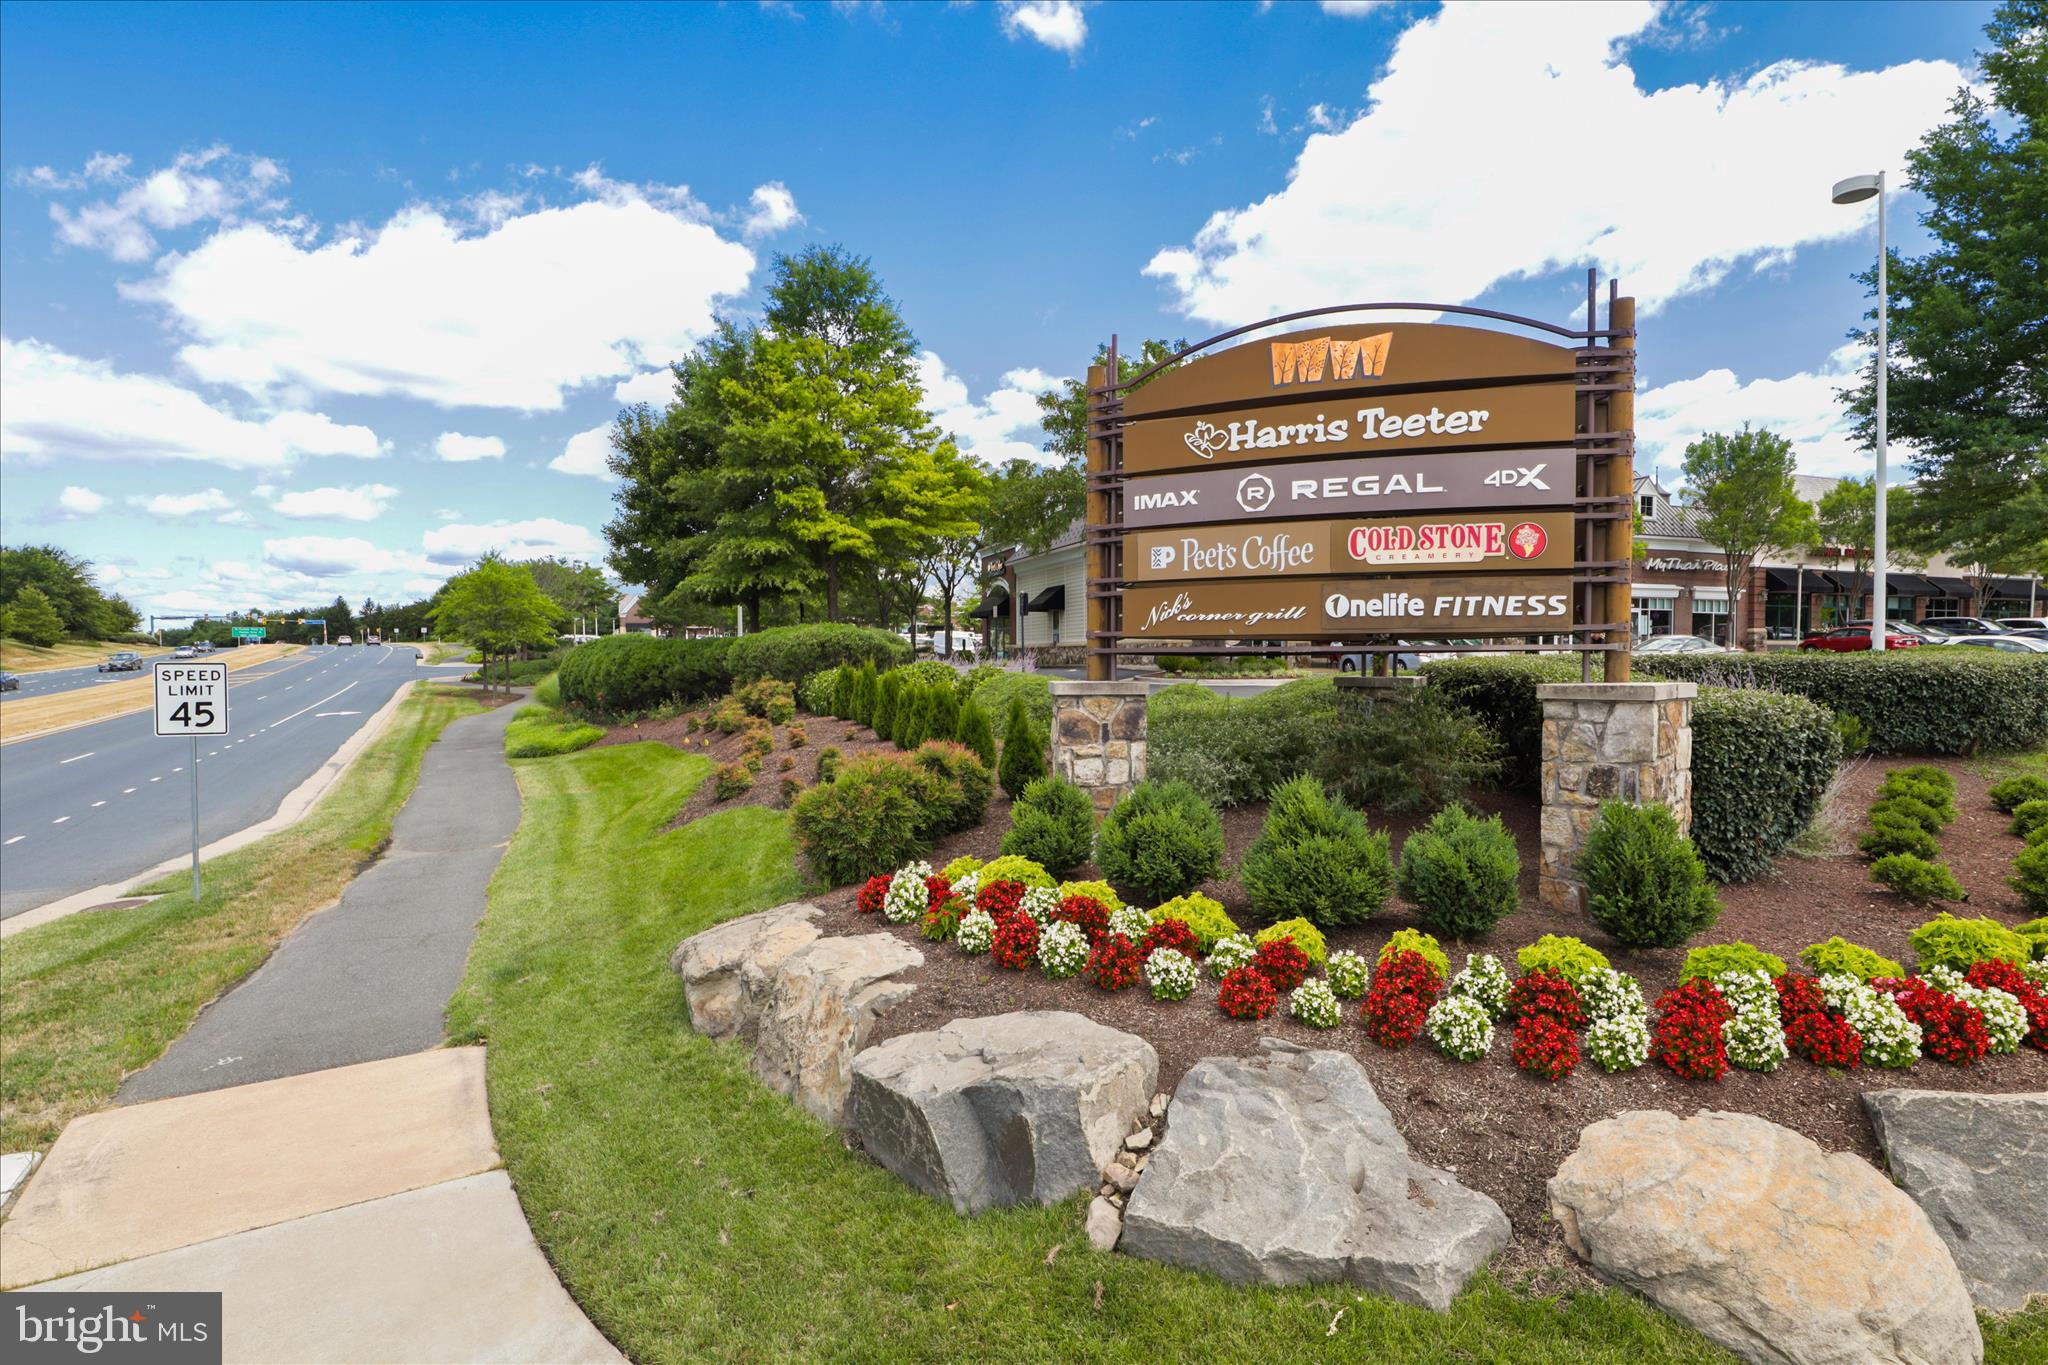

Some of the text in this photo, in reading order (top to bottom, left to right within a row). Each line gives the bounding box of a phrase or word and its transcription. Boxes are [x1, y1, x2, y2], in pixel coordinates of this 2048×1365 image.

[1227, 407, 1490, 451] Harris Teeter
[1291, 473, 1444, 500] REGAL
[1484, 463, 1551, 490] 4DX
[1134, 490, 1199, 510] IMAX
[1180, 538, 1237, 572] Peet's
[1242, 533, 1314, 572] Coffee
[1349, 523, 1503, 558] COLD STONE
[1375, 551, 1475, 562] CREAMERY
[1140, 591, 1193, 631] Nick's
[1176, 606, 1307, 626] corner grill
[1433, 595, 1568, 617] FITNESS
[162, 670, 221, 681] SPEED
[168, 685, 214, 696] LIMIT
[169, 701, 215, 727] 45
